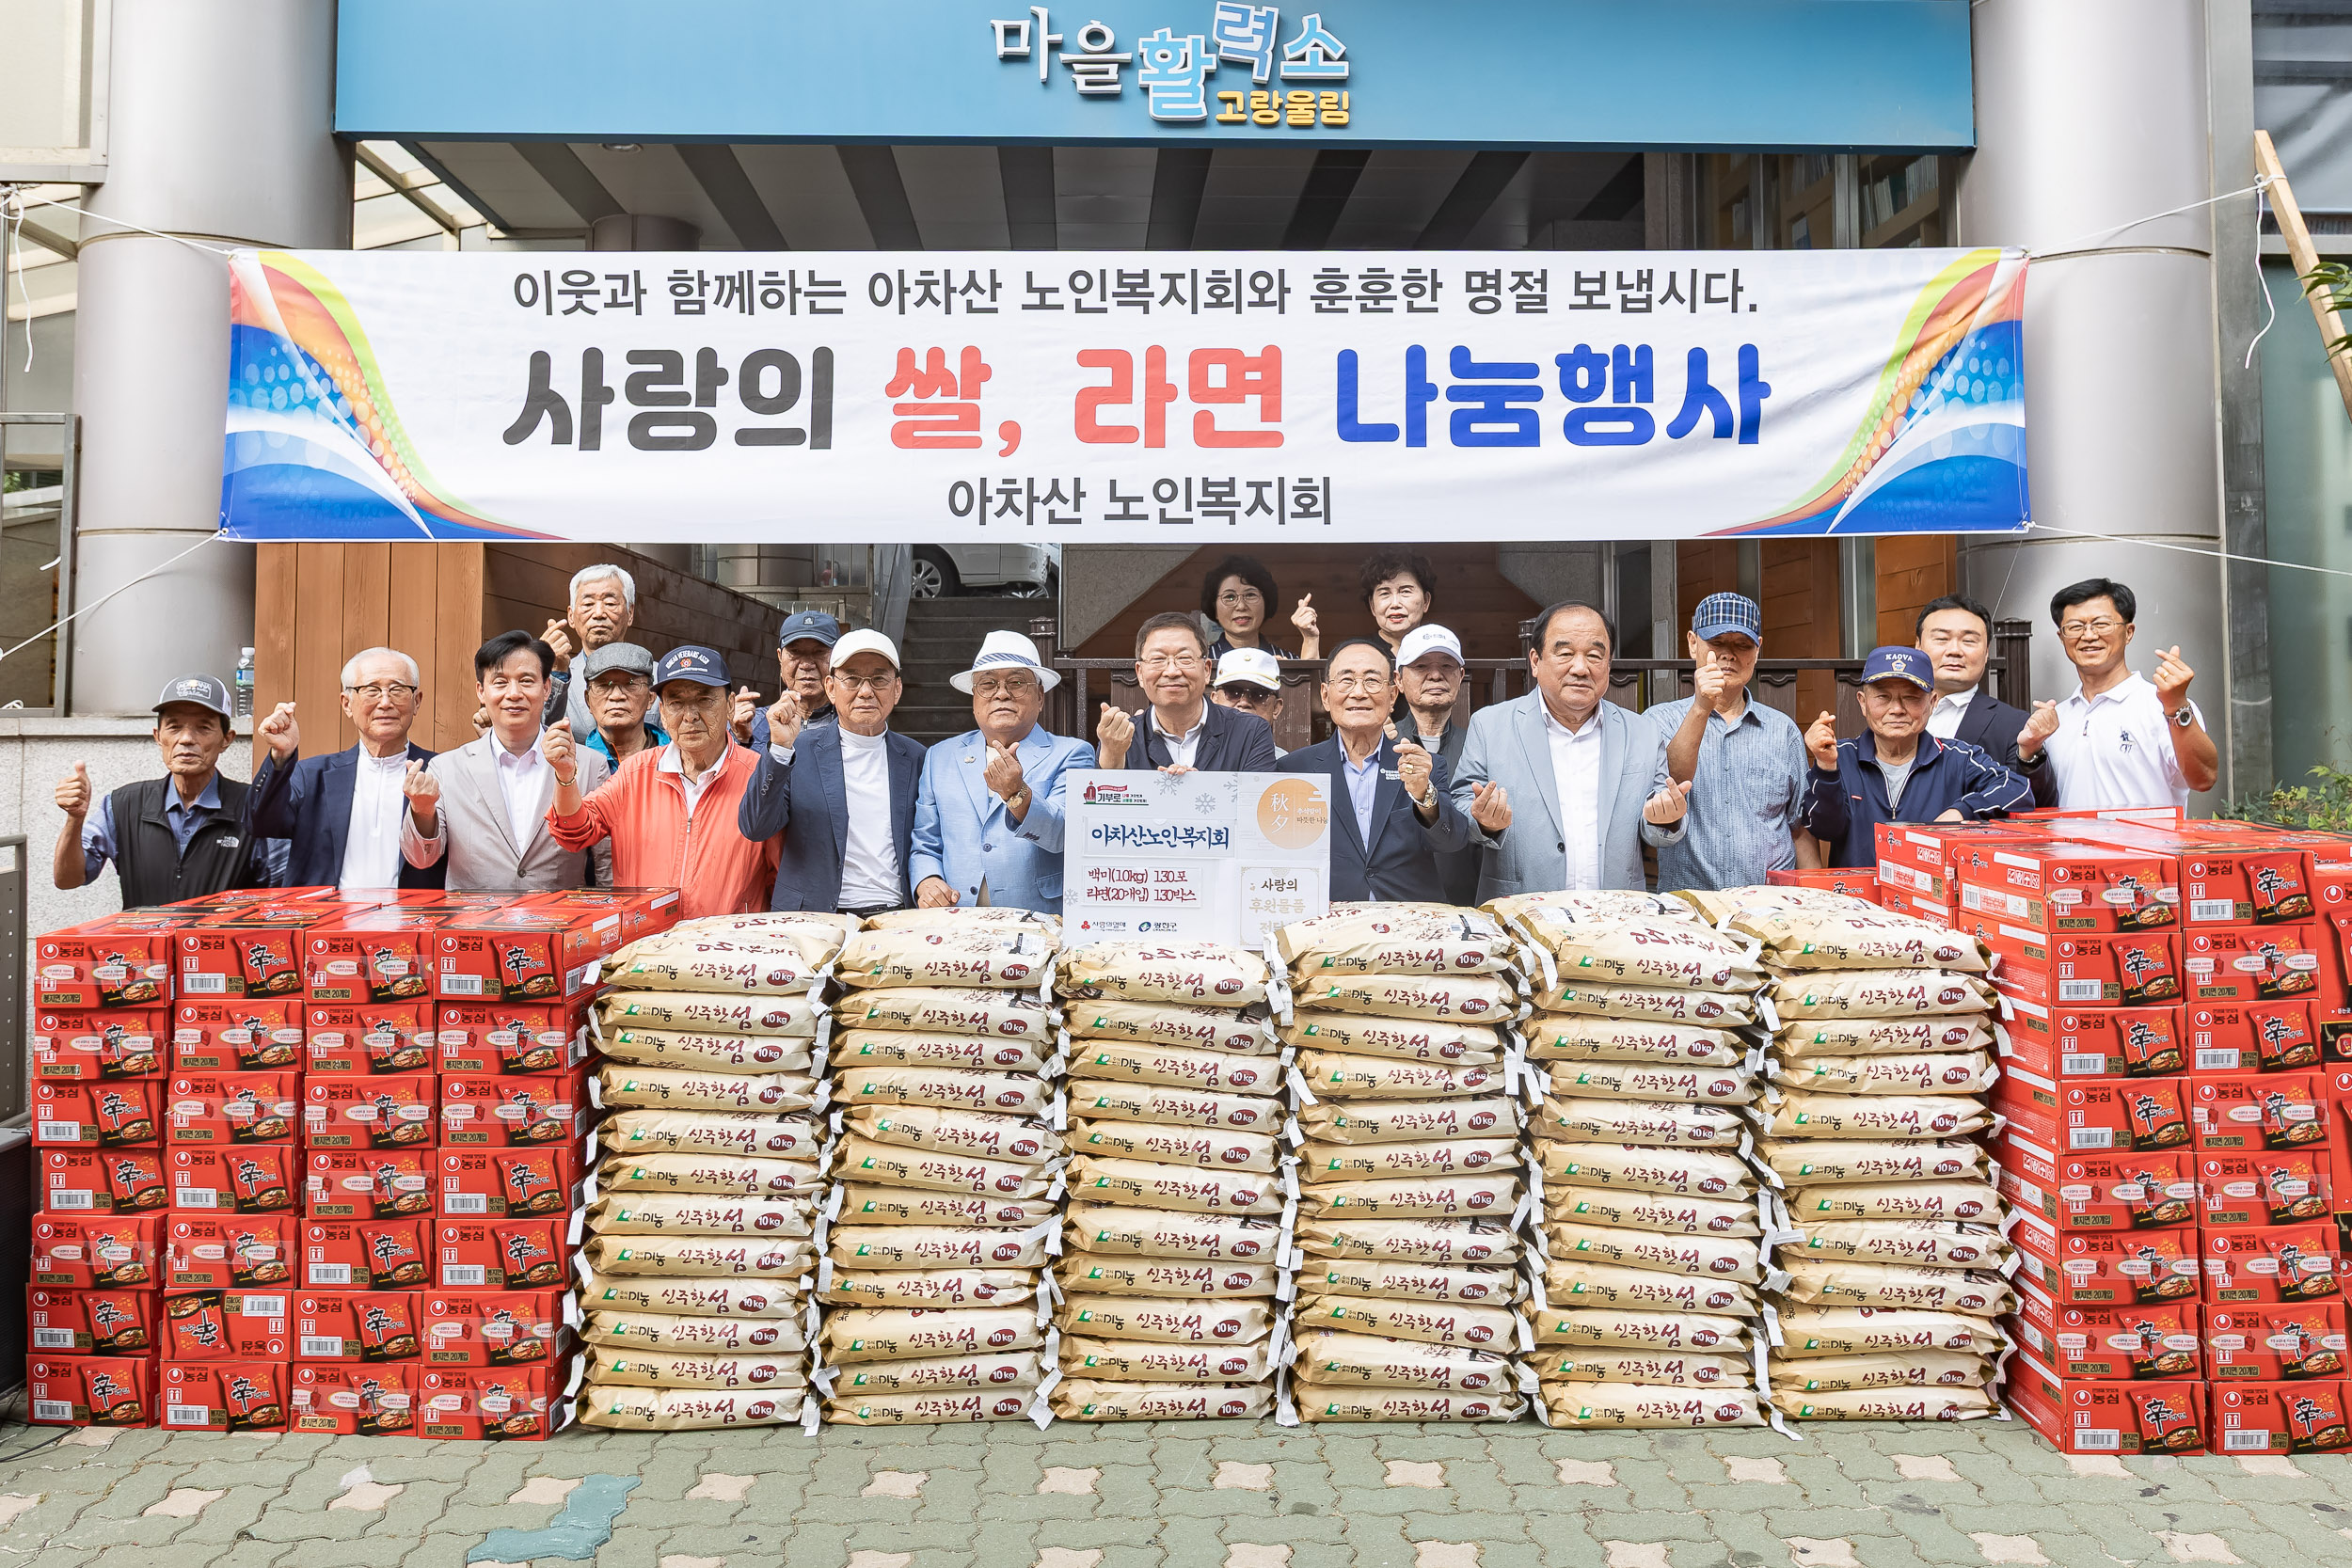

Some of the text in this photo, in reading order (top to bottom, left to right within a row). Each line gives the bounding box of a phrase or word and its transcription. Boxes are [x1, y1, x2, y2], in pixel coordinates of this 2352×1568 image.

[1216, 89, 1350, 126] 고랑울림
[514, 267, 1757, 315] 이웃과 함께하는 아차산 노인복지회와 훈훈한 명절 보냅시다.
[502, 342, 1772, 458] 사랑의 쌀, 라면 나눔행사
[947, 476, 1332, 526] 아차산 노인복지회
[1884, 653, 1914, 662] KAOVA
[1097, 793, 1121, 803] 기부로
[1270, 792, 1290, 834] 秋夕
[1091, 823, 1230, 850] 아차산노인복지회
[1088, 867, 1149, 883] 백미(10kg)
[2070, 869, 2096, 880] 농심
[2207, 863, 2233, 875] 농심
[1087, 886, 1197, 902] 라면(20개입) 130박스
[1261, 878, 1298, 892] 사랑의
[2257, 867, 2284, 903] 辛
[1248, 898, 1306, 915] 후원물품
[58, 947, 84, 958] 농심
[199, 941, 225, 950] 농심
[328, 941, 354, 952] 농심
[458, 941, 483, 951] 농심
[1859, 940, 1925, 964] 신주한섬
[2075, 943, 2102, 955] 농심
[248, 943, 275, 978] 辛
[506, 946, 532, 982] 辛
[924, 959, 991, 984] 신주한섬
[2125, 949, 2153, 985] 辛
[690, 963, 757, 990] 신주한섬
[1138, 972, 1205, 998] 신주한섬
[1383, 989, 1450, 1016] 신주한섬
[1859, 985, 1929, 1011] 신주한섬
[461, 1012, 485, 1023] 농심
[921, 1010, 989, 1035] 신주한섬
[1612, 1034, 1678, 1058] 신주한섬
[1868, 1023, 1933, 1050] 신주한섬
[1631, 1073, 1698, 1099] 신주한섬
[1391, 1109, 1458, 1135] 신주한섬
[1852, 1110, 1923, 1135] 신주한섬
[687, 1128, 757, 1155] 신주한섬
[1145, 1137, 1211, 1166] 신주한섬
[1385, 1148, 1454, 1174] 신주한섬
[2085, 1165, 2111, 1177] 농심
[1622, 1166, 1689, 1193] 신주한섬
[675, 1208, 745, 1233] 신주한섬
[919, 1200, 987, 1225] 신주한섬
[326, 1229, 351, 1241] 농심
[915, 1240, 989, 1270] 신주한섬
[1146, 1266, 1215, 1294] 신주한섬
[1136, 1313, 1204, 1340] 신주한섬
[1388, 1312, 1454, 1339] 신주한섬
[1613, 1323, 1680, 1349] 신주한섬
[315, 1371, 340, 1383] 농심
[914, 1395, 983, 1424] 신주한섬
[1383, 1398, 1450, 1418] 신주한섬
[2092, 1392, 2119, 1403] 농심
[2243, 1393, 2268, 1404] 농심
[667, 1398, 738, 1425] 신주한섬
[2145, 1399, 2172, 1434] 辛
[2295, 1398, 2322, 1434] 辛
